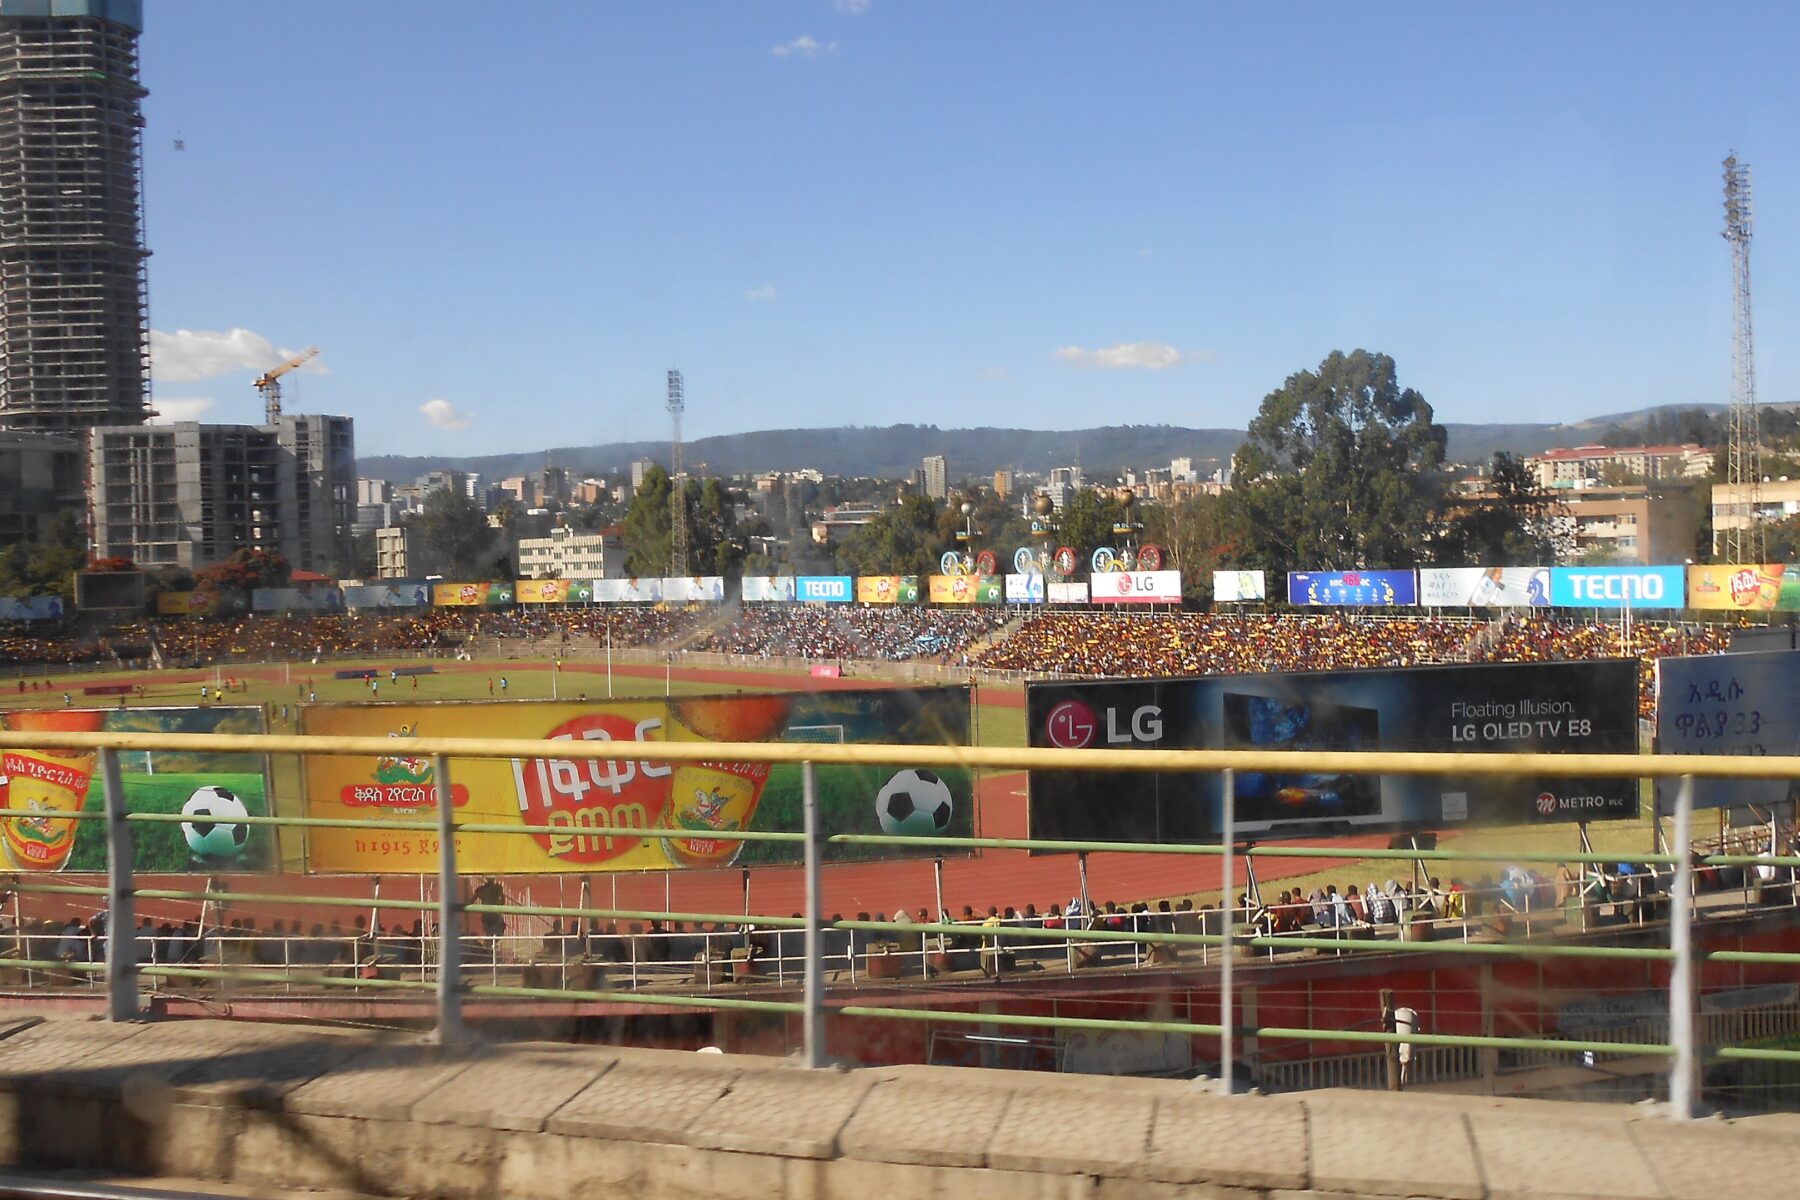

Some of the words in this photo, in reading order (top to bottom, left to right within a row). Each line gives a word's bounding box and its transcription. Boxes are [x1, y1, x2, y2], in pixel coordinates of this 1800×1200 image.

[804, 580, 844, 597] TECNO
[1136, 576, 1154, 592] LG
[1567, 574, 1664, 600] TECNO
[1452, 700, 1515, 719] Floating
[1520, 698, 1575, 715] Illusion.
[1106, 705, 1163, 743] LG
[1452, 724, 1477, 742] LG
[1482, 722, 1532, 741] OLED
[1535, 720, 1562, 738] TV
[1568, 719, 1592, 737] E8
[1559, 796, 1604, 809] METRO
